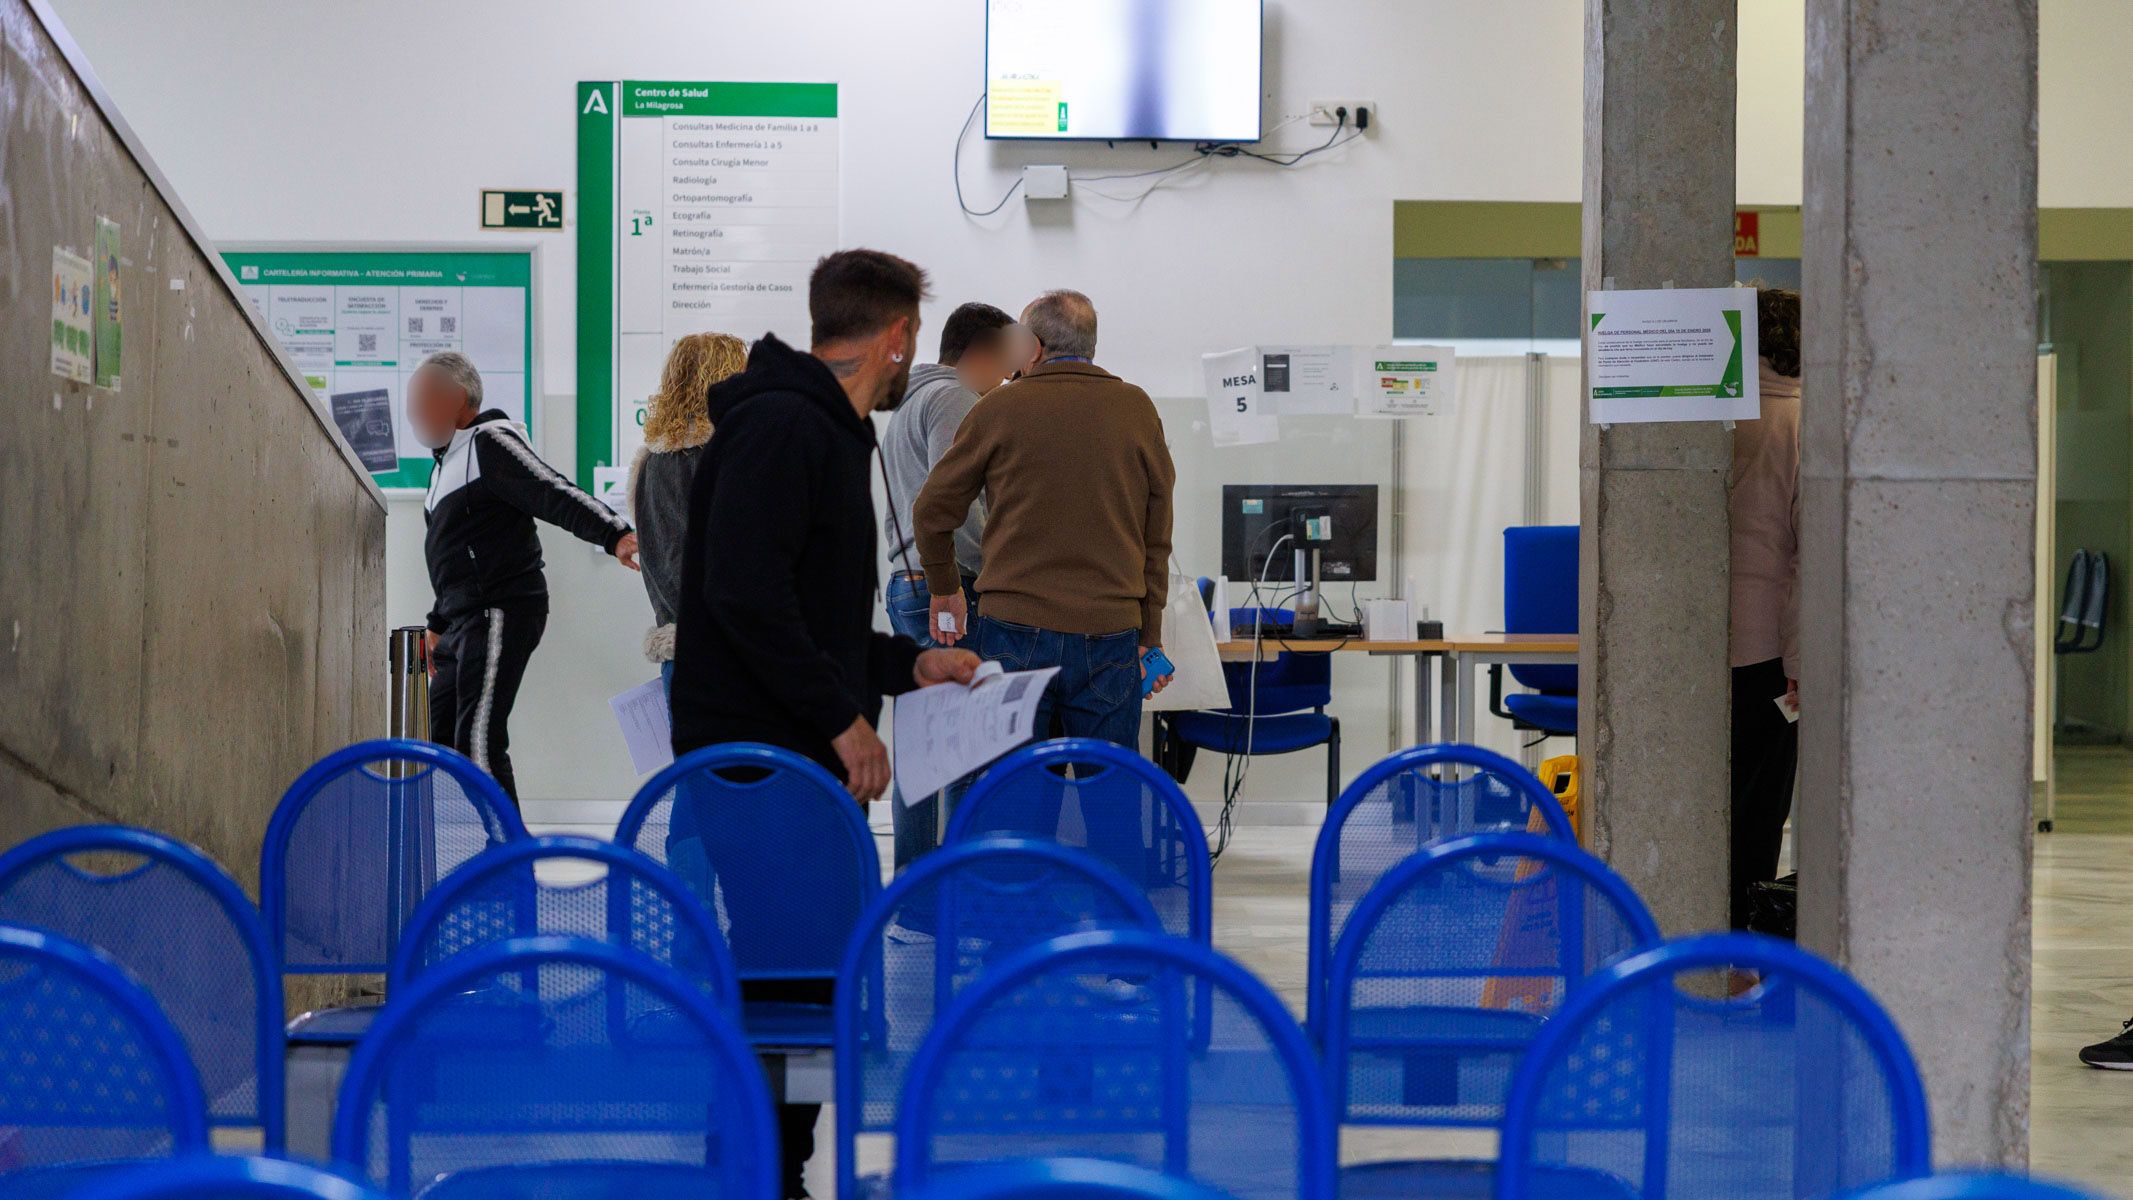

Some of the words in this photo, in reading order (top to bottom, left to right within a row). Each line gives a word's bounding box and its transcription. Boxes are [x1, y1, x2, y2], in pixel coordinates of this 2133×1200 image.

[635, 88, 667, 98] Centro
[668, 88, 681, 98] de
[682, 88, 709, 98] Salud
[635, 101, 645, 109] La
[646, 101, 684, 111] Milagrosa
[672, 122, 714, 131] Consultas
[715, 122, 753, 132] Medicina
[755, 122, 765, 132] de
[767, 123, 798, 132] Familia
[800, 124, 804, 132] 1
[813, 124, 819, 133] 8
[672, 140, 714, 149] Consultas
[715, 140, 762, 149] Enfermería
[763, 141, 768, 149] 1
[770, 142, 776, 150] a
[777, 141, 783, 150] 5
[672, 157, 709, 167] Consulta
[711, 157, 741, 169] Cirugía
[742, 158, 769, 167] Menor
[672, 175, 717, 186] Radiología
[672, 193, 753, 204] Ortopantomografía
[672, 211, 711, 222] Ecografía
[672, 228, 723, 239] Retinografía
[672, 246, 711, 257] Matrón/a
[263, 268, 308, 277] CARTELERÍA
[308, 269, 360, 277] INFORMATIVA
[365, 268, 404, 278] ATENCIÓN
[406, 270, 443, 278] PRIMARIA
[672, 264, 704, 276] Trabajo
[705, 264, 731, 274] Social
[672, 282, 719, 291] Enfermería
[720, 282, 755, 292] Gestoría
[756, 283, 767, 292] de
[768, 283, 793, 293] Casos
[672, 300, 711, 310] Dirección
[1222, 374, 1257, 388] MESA
[1236, 396, 1248, 413] 5
